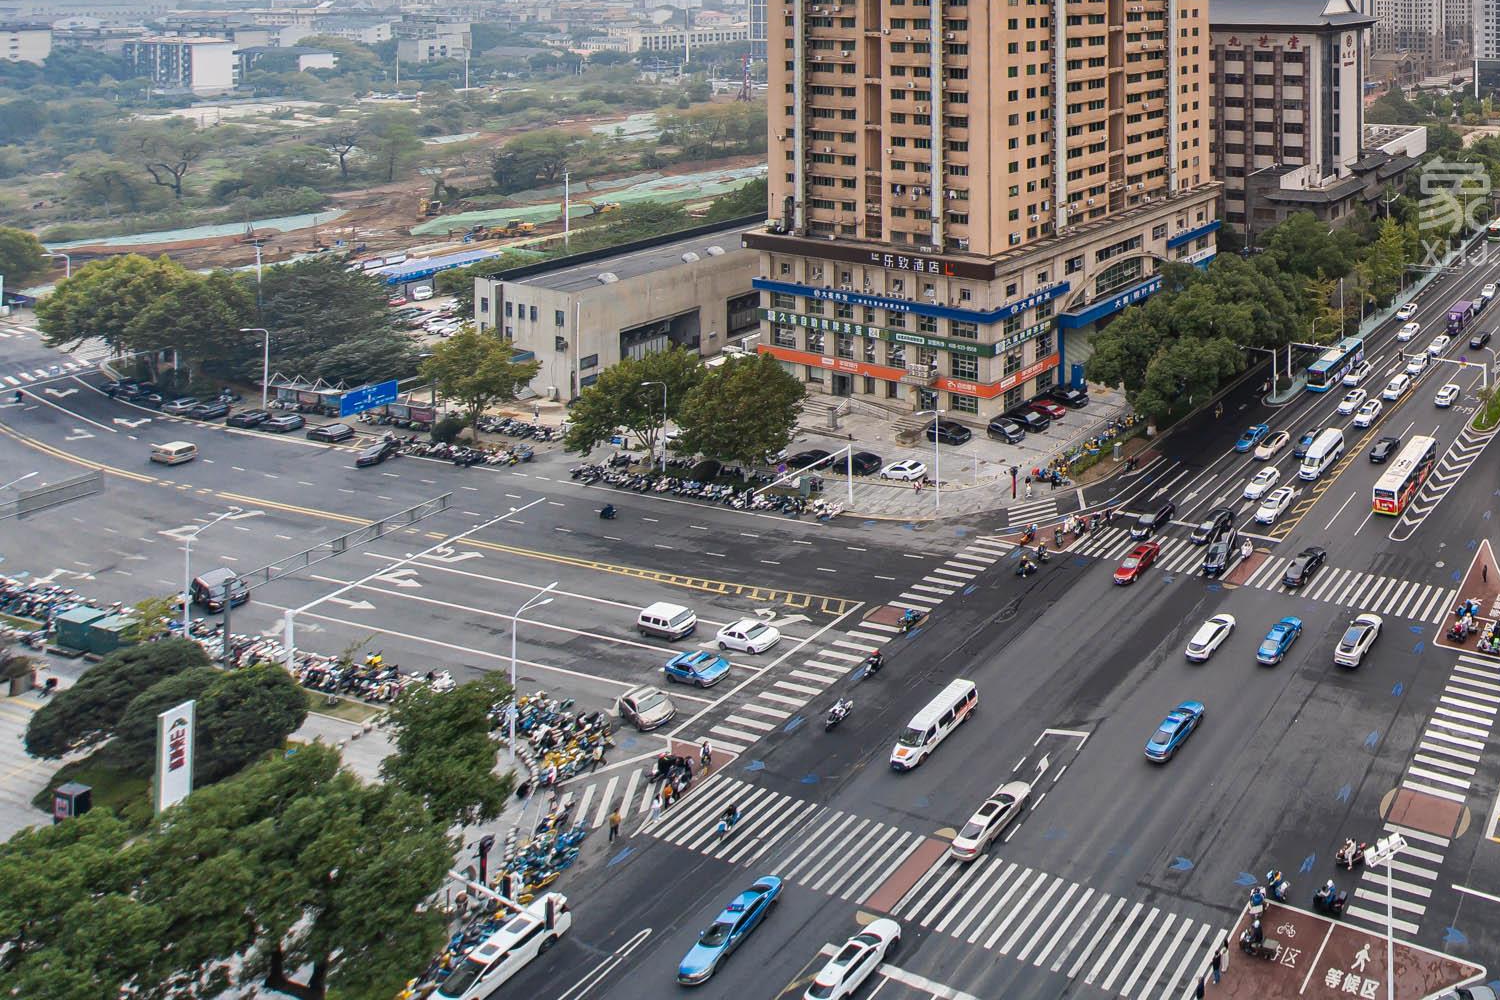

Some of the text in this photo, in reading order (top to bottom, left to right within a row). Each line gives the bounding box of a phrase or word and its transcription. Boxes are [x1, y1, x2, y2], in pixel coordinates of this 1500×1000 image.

[1209, 34, 1300, 49] 九芝堂
[884, 254, 940, 274] 乐致酒店
[1325, 967, 1380, 999] 等候区
